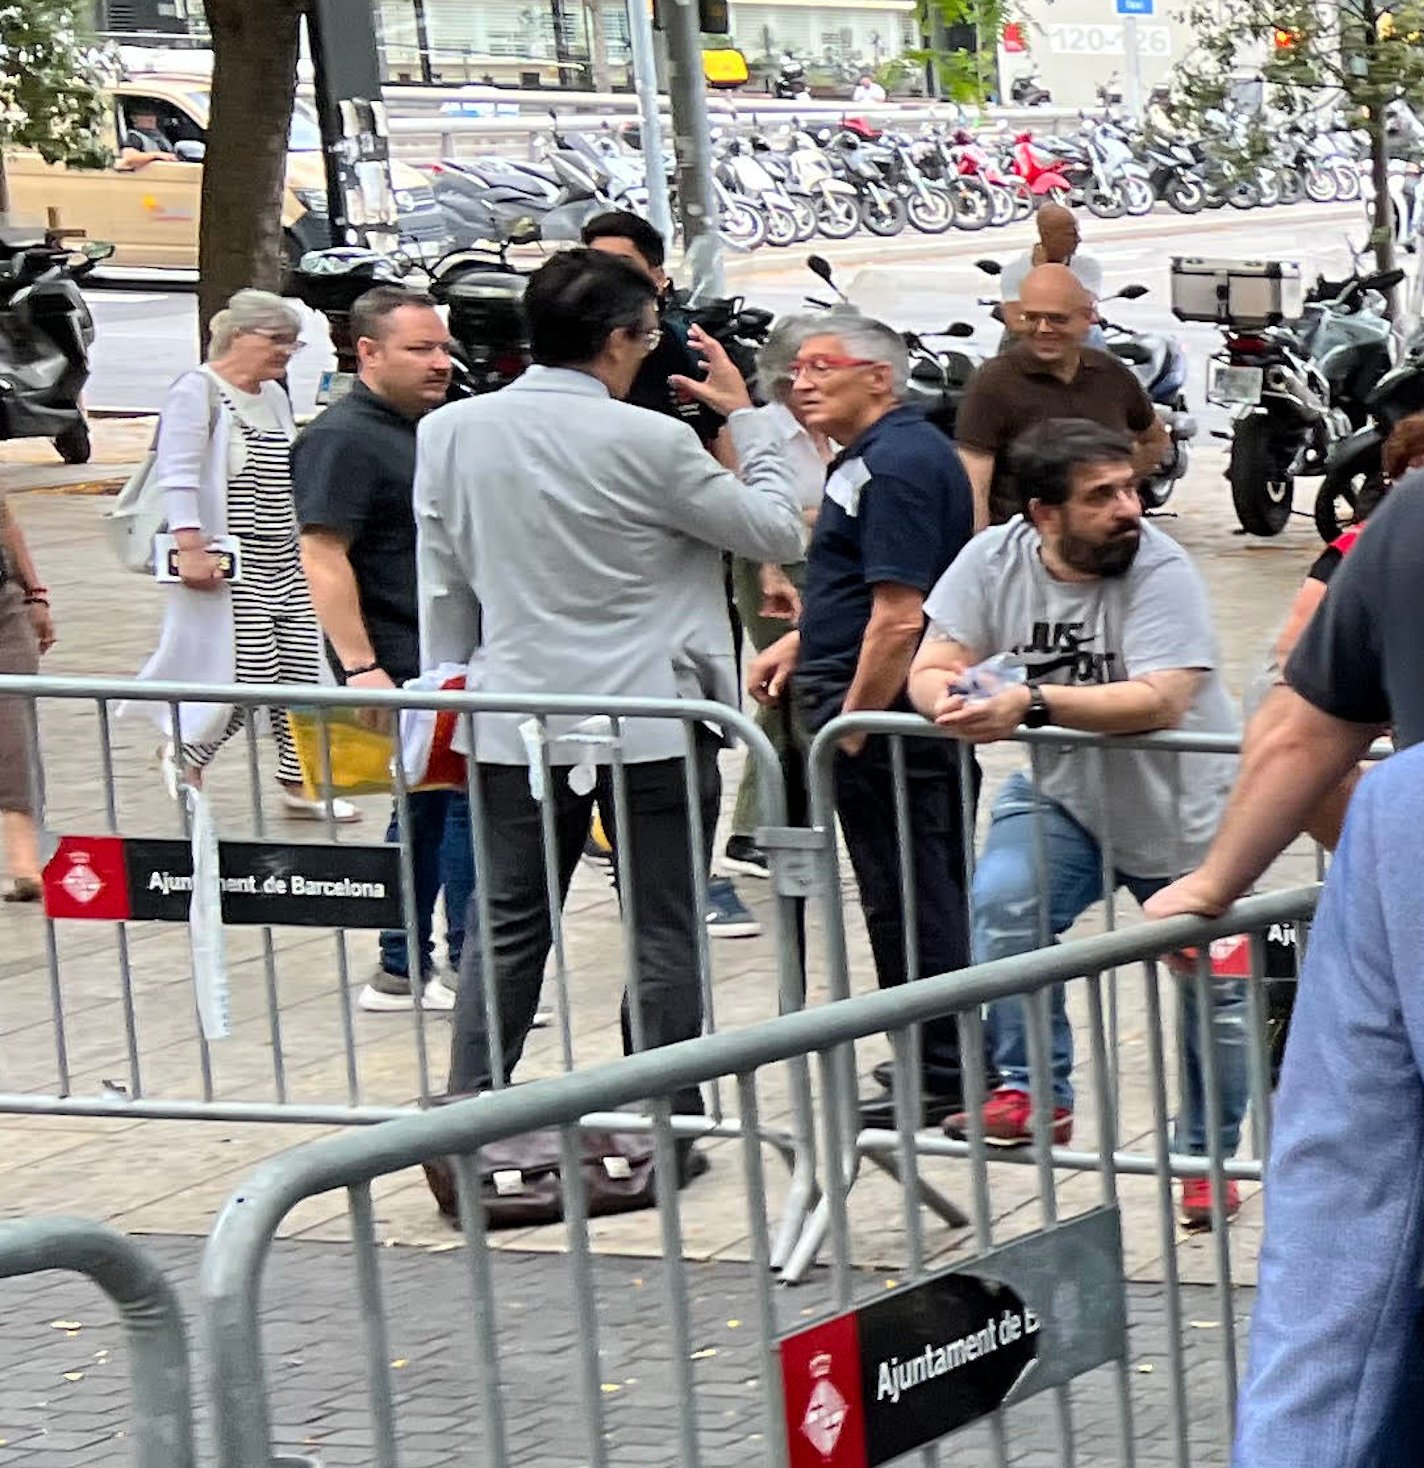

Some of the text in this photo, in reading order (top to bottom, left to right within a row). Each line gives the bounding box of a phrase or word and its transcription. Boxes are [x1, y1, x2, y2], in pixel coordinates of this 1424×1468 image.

[263, 876, 287, 894] de
[291, 876, 386, 898] Barcelona
[877, 1317, 998, 1404] Ajuntament
[999, 1309, 1022, 1346] de
